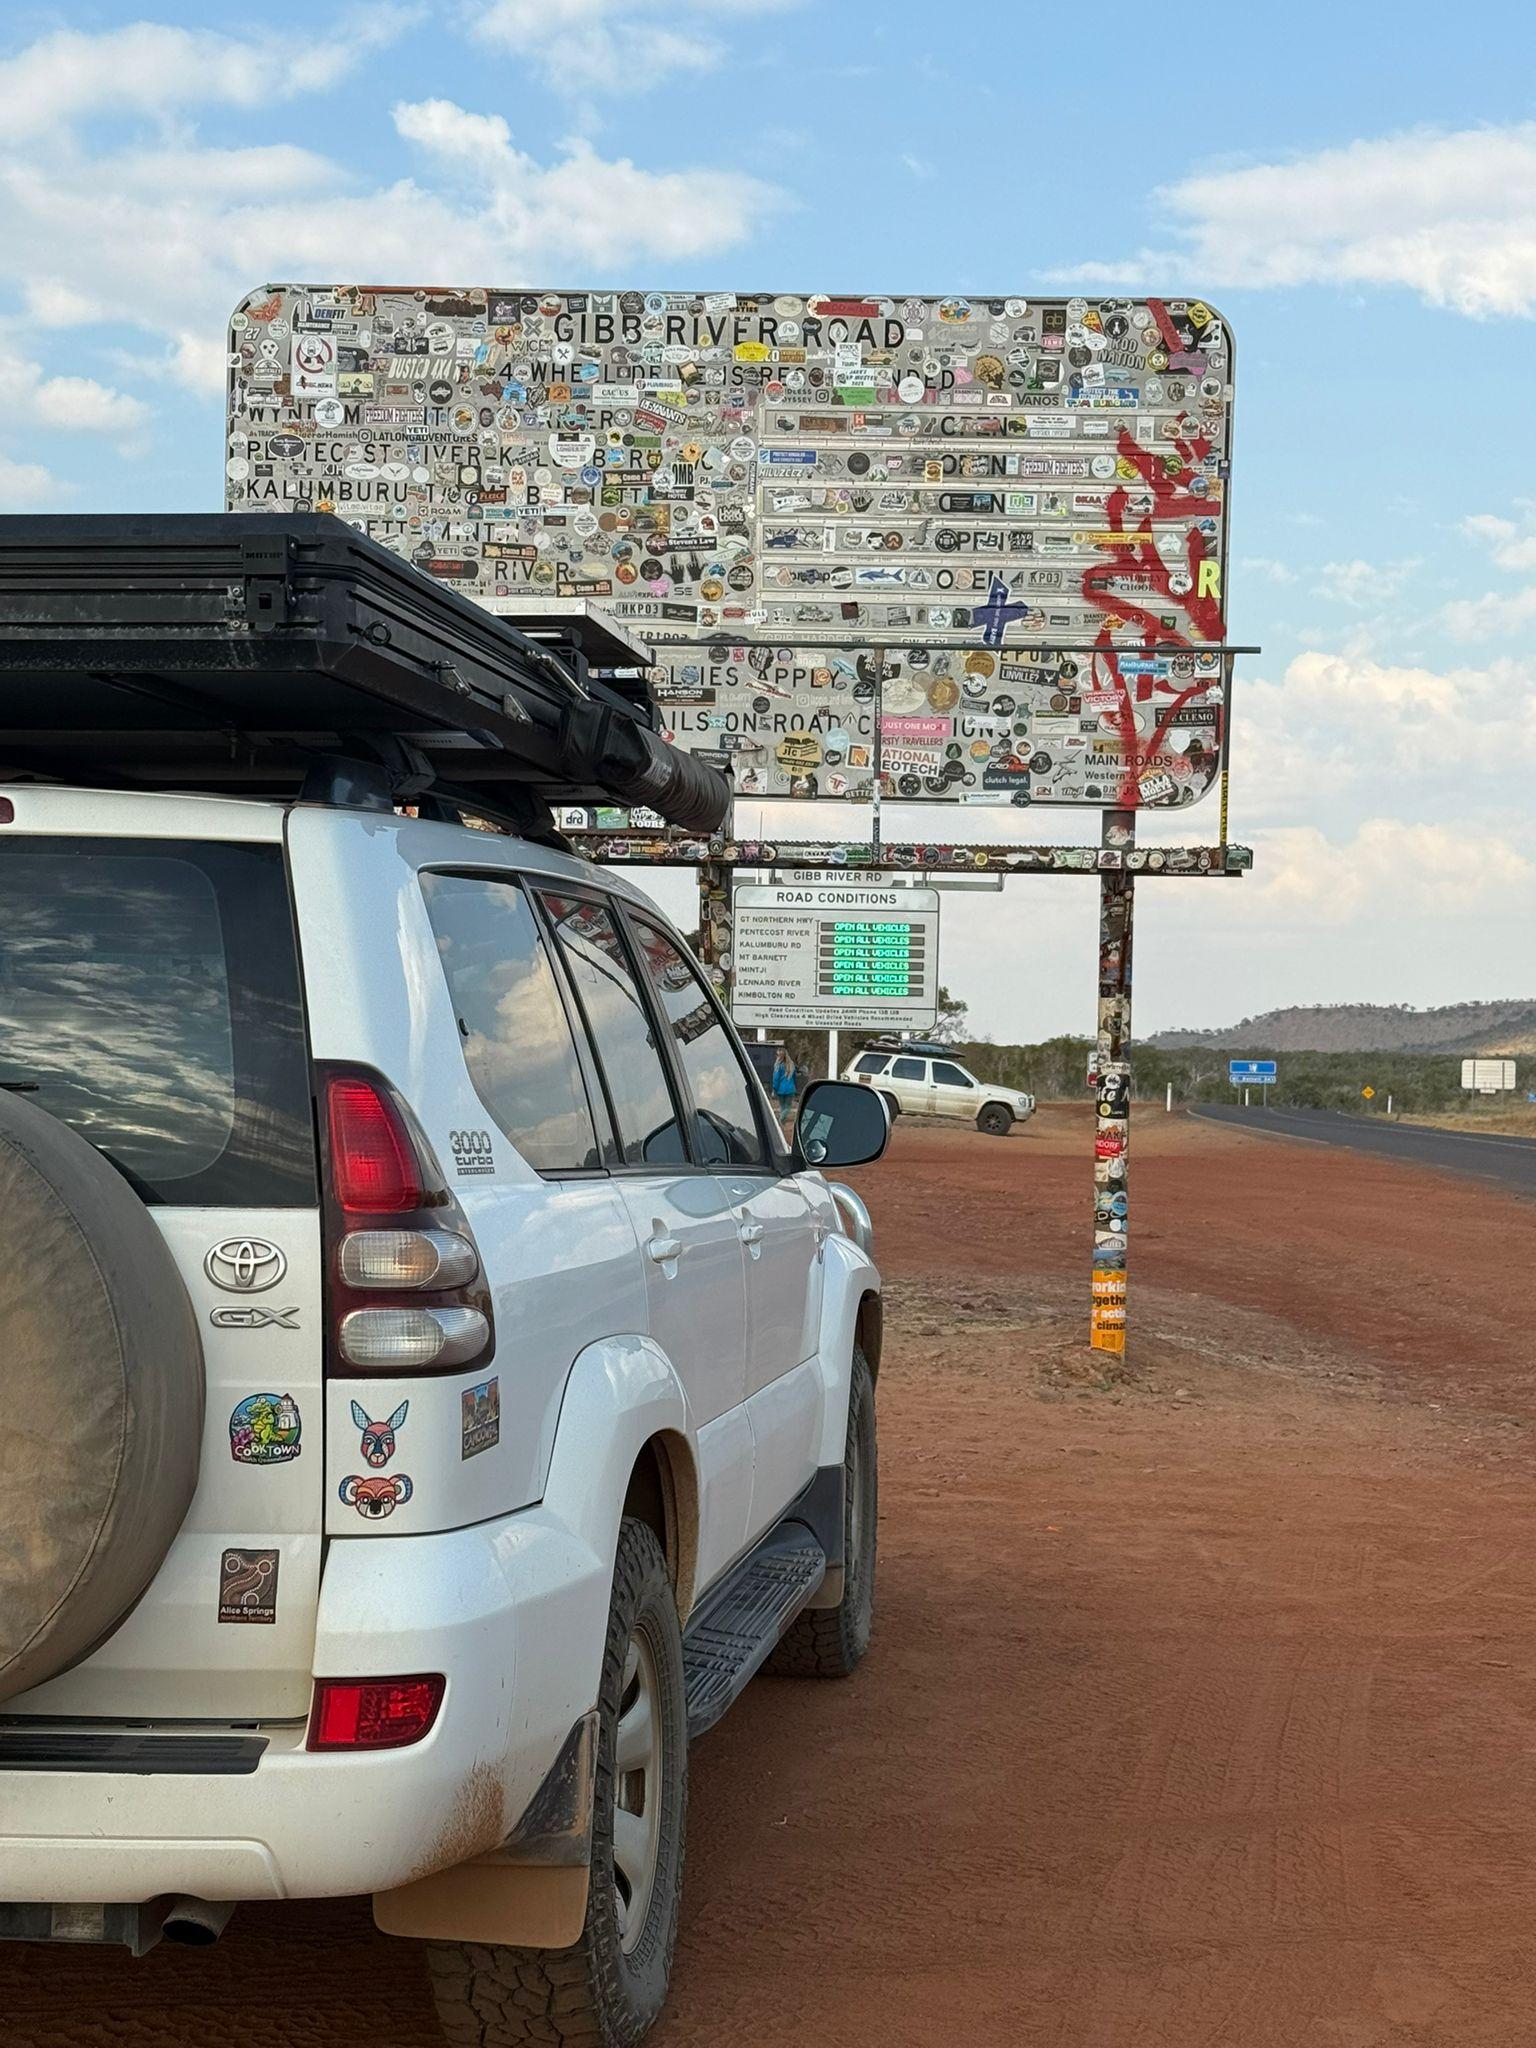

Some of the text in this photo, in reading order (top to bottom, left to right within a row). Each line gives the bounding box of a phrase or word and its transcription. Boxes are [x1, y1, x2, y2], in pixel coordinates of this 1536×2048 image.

[245, 327, 260, 340] 27
[554, 313, 906, 349] GIBB RIVER ROAD
[1096, 348, 1146, 370] NATION
[499, 362, 955, 390] 4 WHEL DRIE IS REONDED
[602, 389, 629, 397] CACUS
[1016, 393, 1059, 406] VANOS
[249, 403, 360, 425] WYNM
[373, 431, 478, 443] LATLONGADVENTURES
[248, 441, 391, 463] PETECST
[407, 445, 481, 466] IVER
[322, 464, 344, 476] KJH
[941, 454, 1008, 475] ON
[247, 479, 408, 502] KALUMBURU
[527, 486, 641, 507] BRTT
[495, 561, 569, 581] RIVR
[937, 570, 1003, 591] OEN
[1120, 583, 1156, 592] CHOOK
[670, 665, 739, 687] LIES
[865, 664, 893, 678] ROKS
[1002, 669, 1040, 684] LINVILLE?
[658, 689, 703, 698] HANSON
[1179, 713, 1214, 721] CLEMO
[725, 713, 757, 733] ON
[774, 714, 841, 734] ROAD
[884, 721, 903, 729] JUST
[902, 737, 943, 746] TRAVELLERS
[882, 749, 938, 764] ATIONAL
[1085, 755, 1173, 767] MAIN ROADS
[882, 760, 938, 776] EOTECH
[984, 776, 1008, 784] clutch
[1085, 770, 1126, 780] Western
[566, 814, 583, 825] drd
[794, 871, 882, 881] GIBB RIVER RD
[777, 892, 897, 904] ROAD CONDITIONS
[834, 924, 910, 932] OPEN ALL VEHICLES
[834, 936, 910, 944] OPEN ALL VEHICLES
[834, 949, 910, 957] OPEN ALL VEHICLES
[833, 962, 909, 970] OPEN ALL VEHICLES
[833, 974, 909, 982] OPEN ALL VEHICLES
[833, 986, 909, 994] OPEN ALL VEHICLES
[449, 1131, 492, 1154] 3000
[455, 1155, 493, 1166] turbo
[210, 1307, 300, 1329] GX
[220, 1606, 274, 1617] Alice Springs
